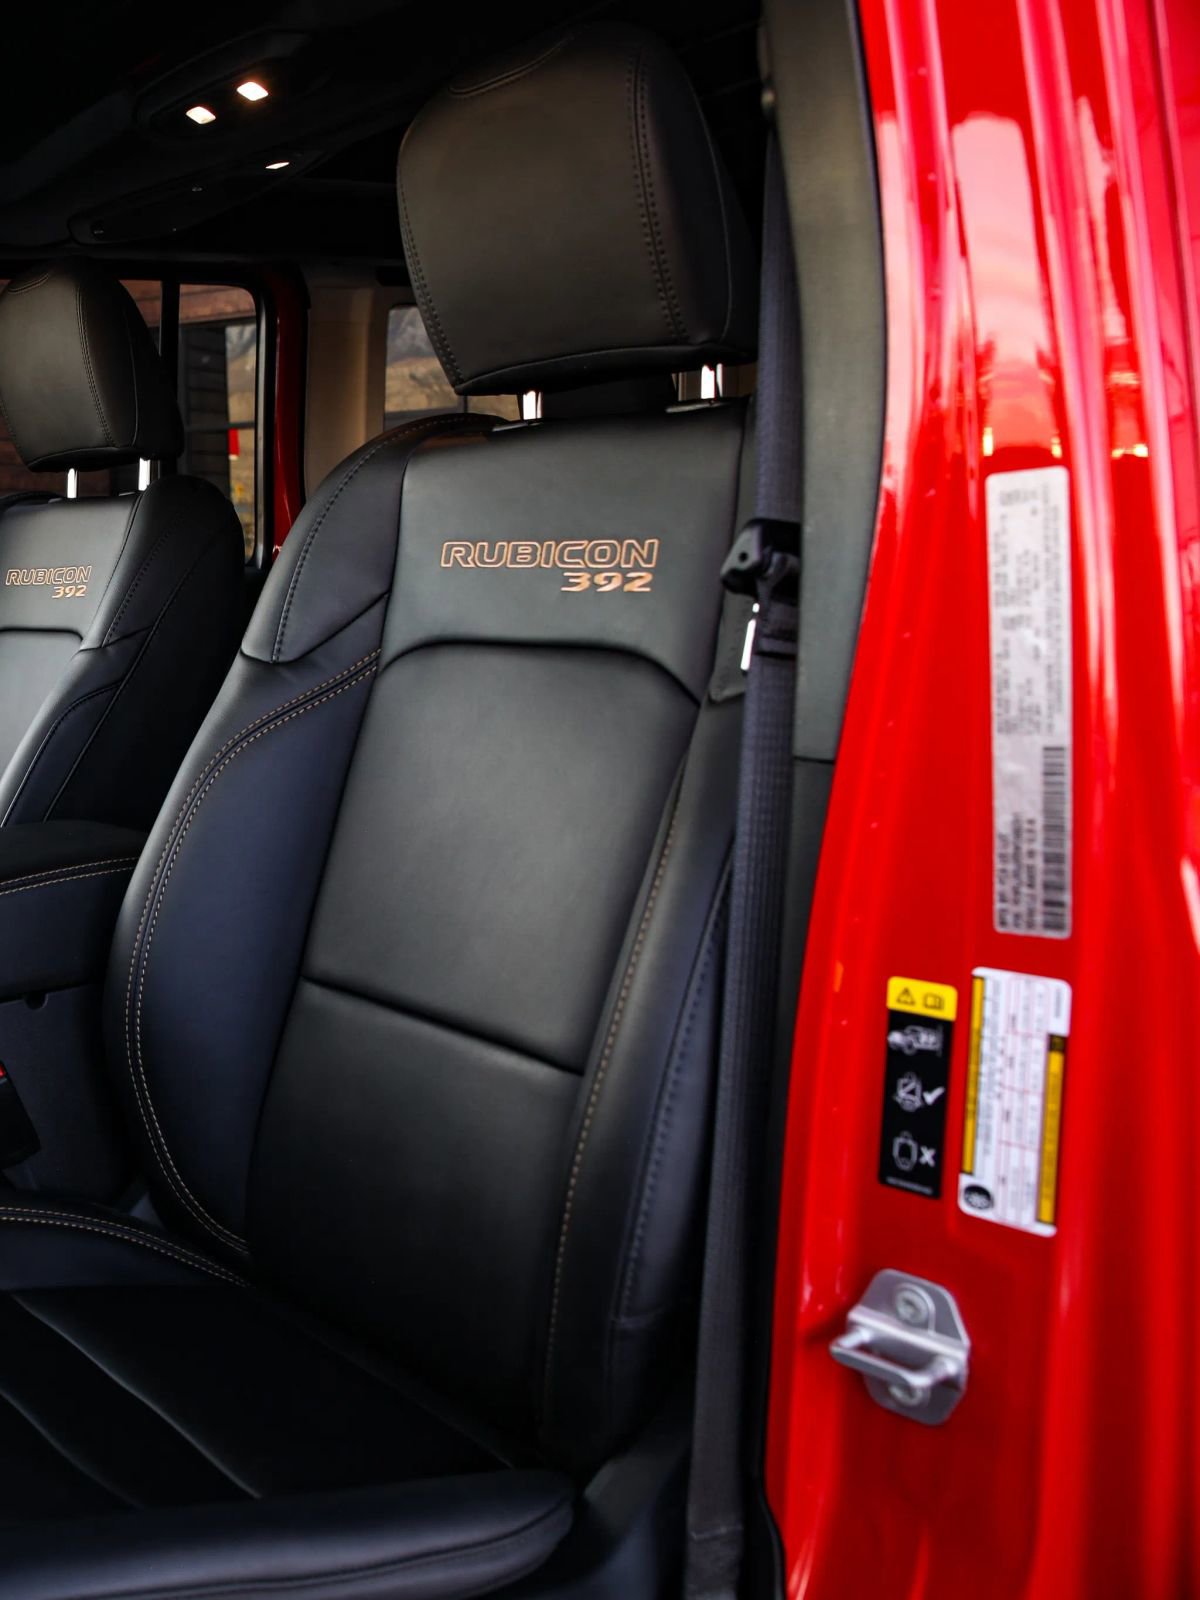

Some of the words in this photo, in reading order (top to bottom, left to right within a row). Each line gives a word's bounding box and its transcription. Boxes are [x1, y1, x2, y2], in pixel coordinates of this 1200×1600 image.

[440, 538, 659, 569] RUBICON
[5, 565, 92, 586] RUBICON
[560, 571, 653, 592] 392
[51, 584, 87, 598] 392
